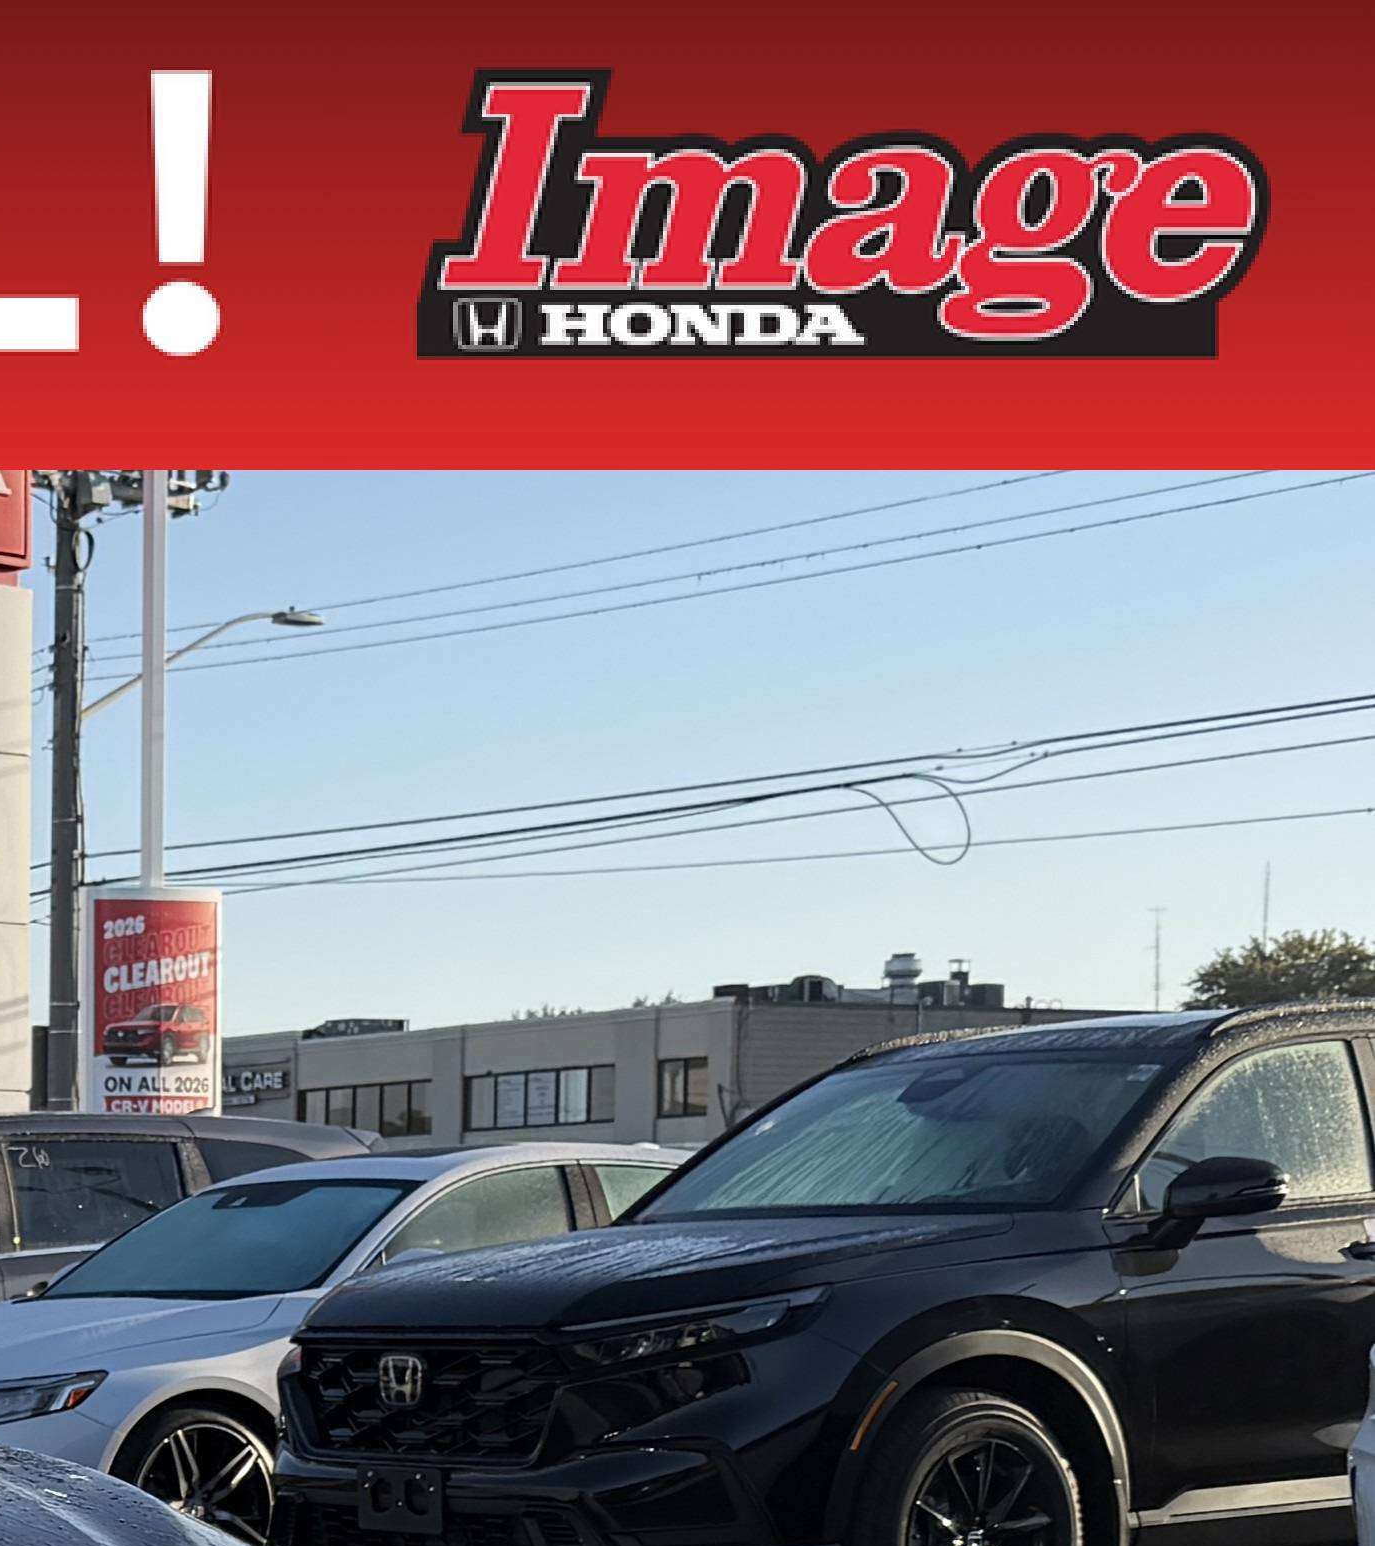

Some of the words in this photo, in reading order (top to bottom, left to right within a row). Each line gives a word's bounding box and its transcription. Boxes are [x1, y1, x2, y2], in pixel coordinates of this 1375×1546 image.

[103, 915, 146, 940] 2026
[103, 951, 211, 993] CLEAROUT
[104, 1076, 132, 1092] ON
[138, 1076, 170, 1092] ALL
[174, 1076, 210, 1094] 2026
[241, 1071, 283, 1090] CARE
[112, 1099, 148, 1114] CR-V
